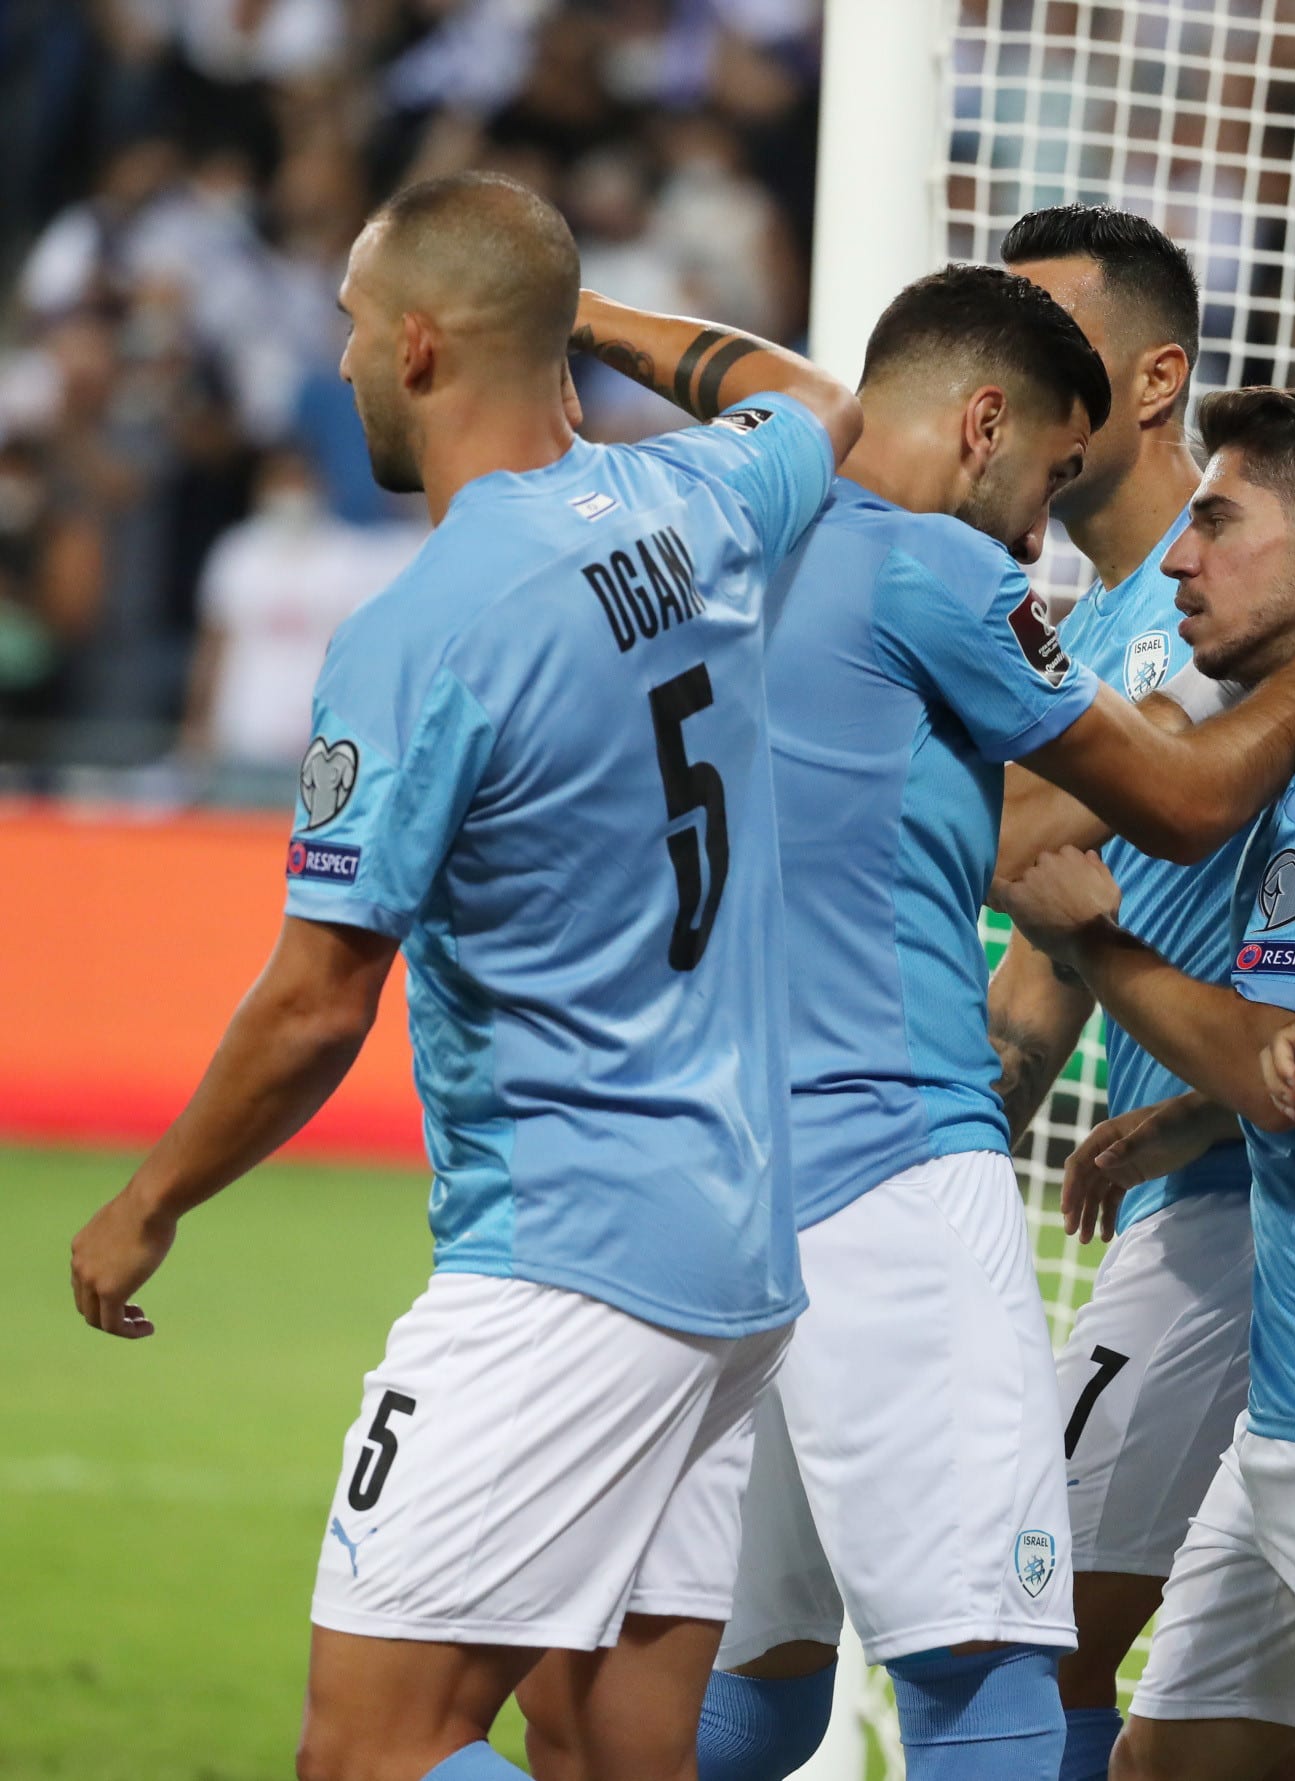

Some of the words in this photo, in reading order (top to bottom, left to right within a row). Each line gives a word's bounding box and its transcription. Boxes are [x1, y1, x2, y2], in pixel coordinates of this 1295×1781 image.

[1134, 639, 1162, 654] ISRAEL
[649, 662, 730, 974] 5
[306, 851, 358, 875] RESPECT
[1065, 1345, 1130, 1460] 7
[349, 1390, 416, 1511] 5
[1023, 1535, 1048, 1548] ISRAEL
